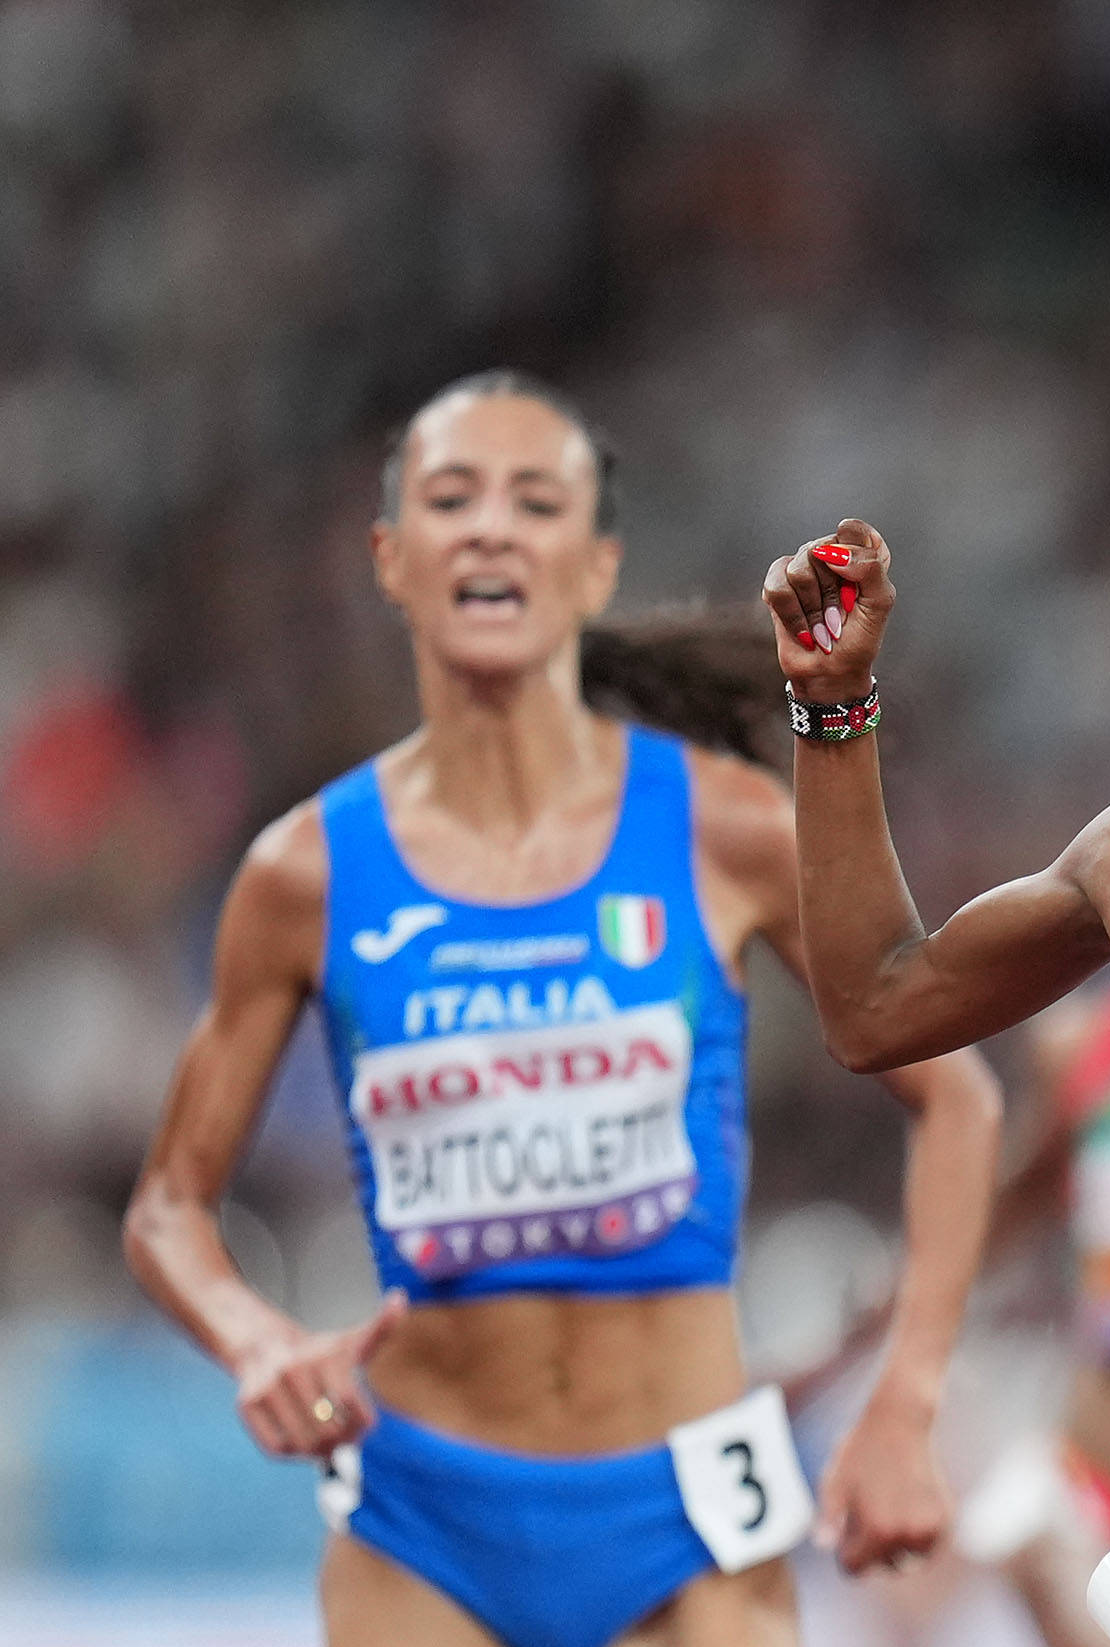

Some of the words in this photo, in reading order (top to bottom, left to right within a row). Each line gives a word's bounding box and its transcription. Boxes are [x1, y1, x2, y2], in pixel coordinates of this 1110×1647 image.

[403, 976, 616, 1037] ITALIA
[367, 1038, 672, 1119] HONDA
[722, 1440, 767, 1532] 3
